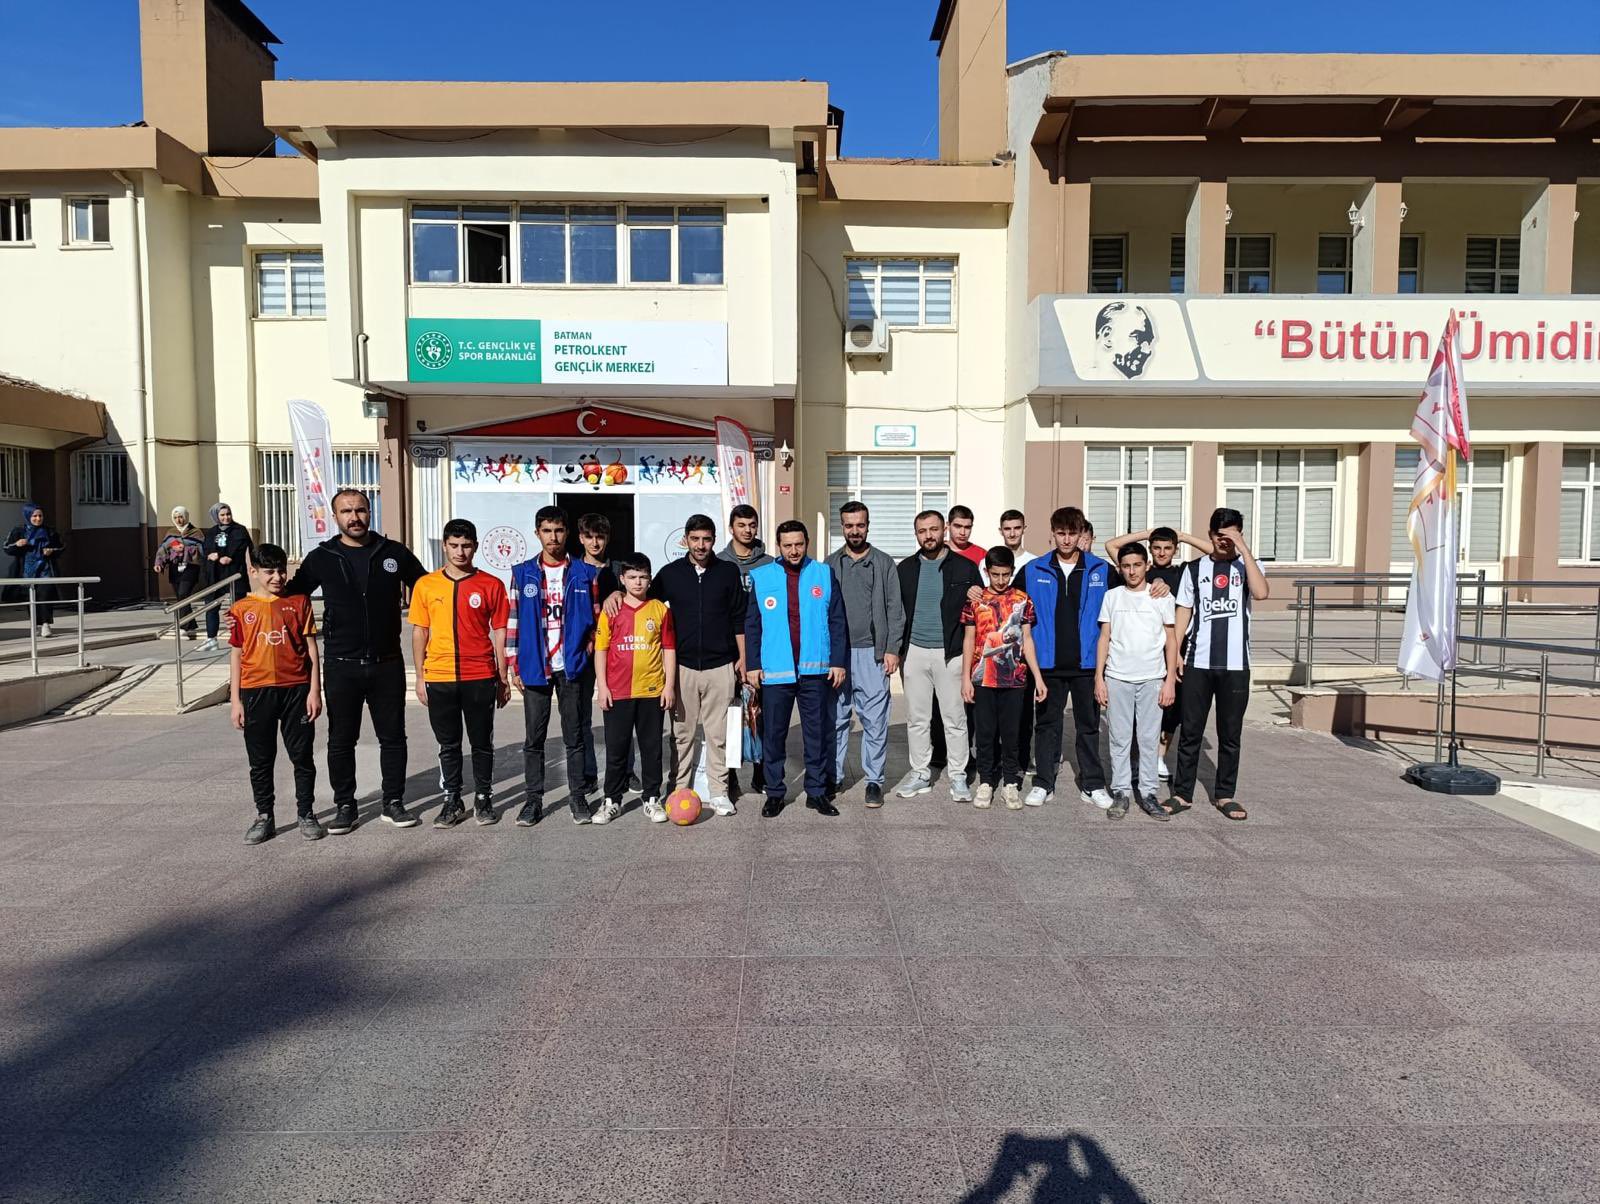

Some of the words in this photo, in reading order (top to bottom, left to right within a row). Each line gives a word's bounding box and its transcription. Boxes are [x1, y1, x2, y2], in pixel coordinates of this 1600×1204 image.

[554, 331, 592, 340] BATMAN
[1455, 310, 1600, 360] Ümidi
[458, 341, 475, 350] T.C.
[478, 339, 520, 352] GENÇLİK
[523, 342, 536, 350] VE
[554, 344, 627, 356] PETROLKENT
[458, 352, 483, 361] SPOR
[486, 351, 536, 361] BAKANLIĞI
[554, 359, 603, 375] GENÇLİK
[605, 360, 655, 373] MERKEZİ
[1203, 597, 1238, 612] beko
[257, 625, 287, 647] nef
